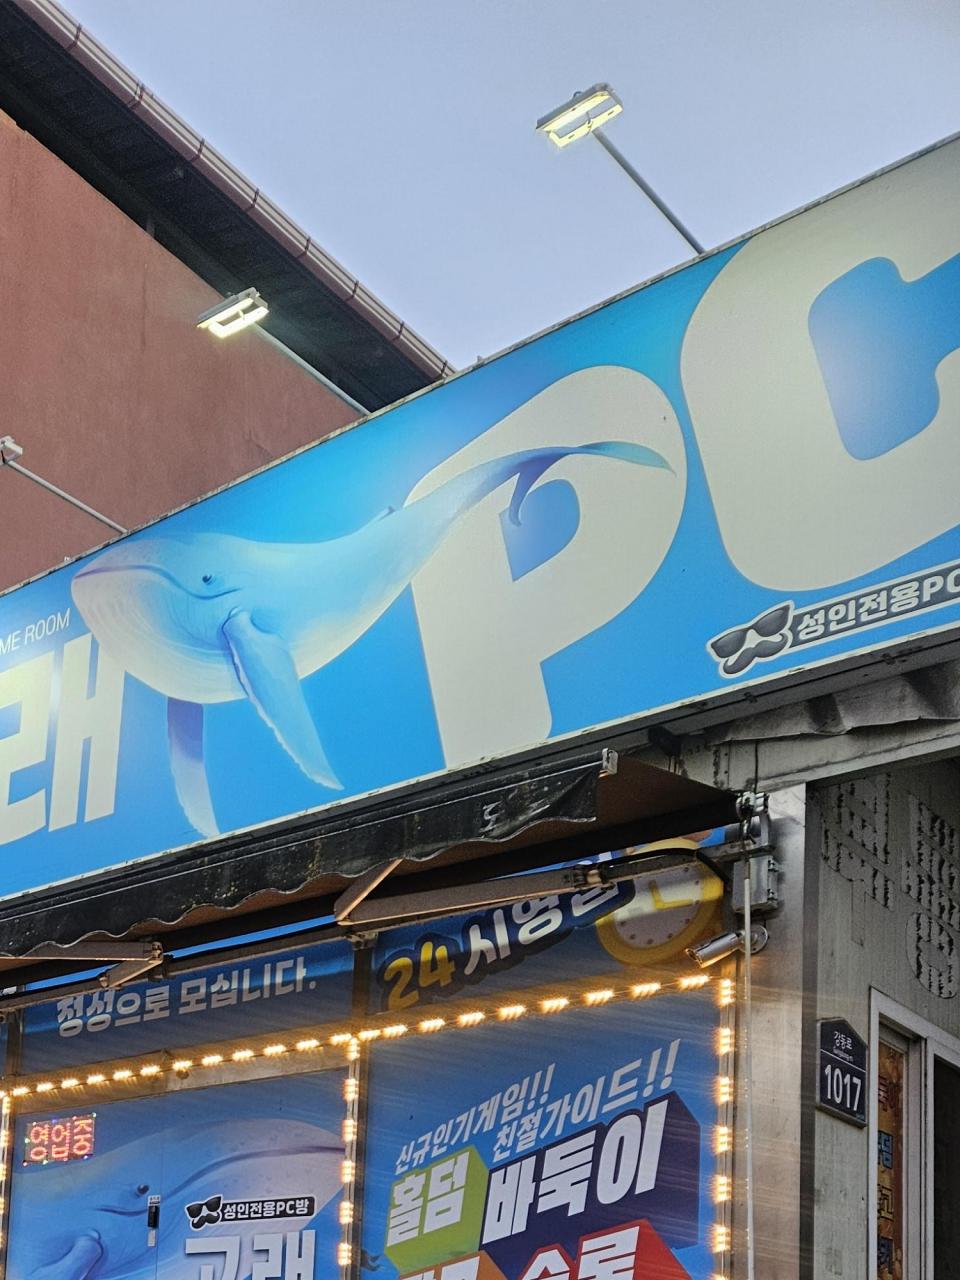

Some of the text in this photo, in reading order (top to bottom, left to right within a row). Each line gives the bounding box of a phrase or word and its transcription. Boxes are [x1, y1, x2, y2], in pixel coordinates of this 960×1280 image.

[402, 137, 960, 770] PC
[25, 608, 71, 648] ROOM
[57, 956, 317, 1038] 정성으로 모십니다.
[824, 1063, 862, 1112] 1017
[29, 1117, 93, 1162] 영업중
[386, 1100, 669, 1248] 홀덤 바둑이
[223, 1198, 310, 1220] 성인전용PC방
